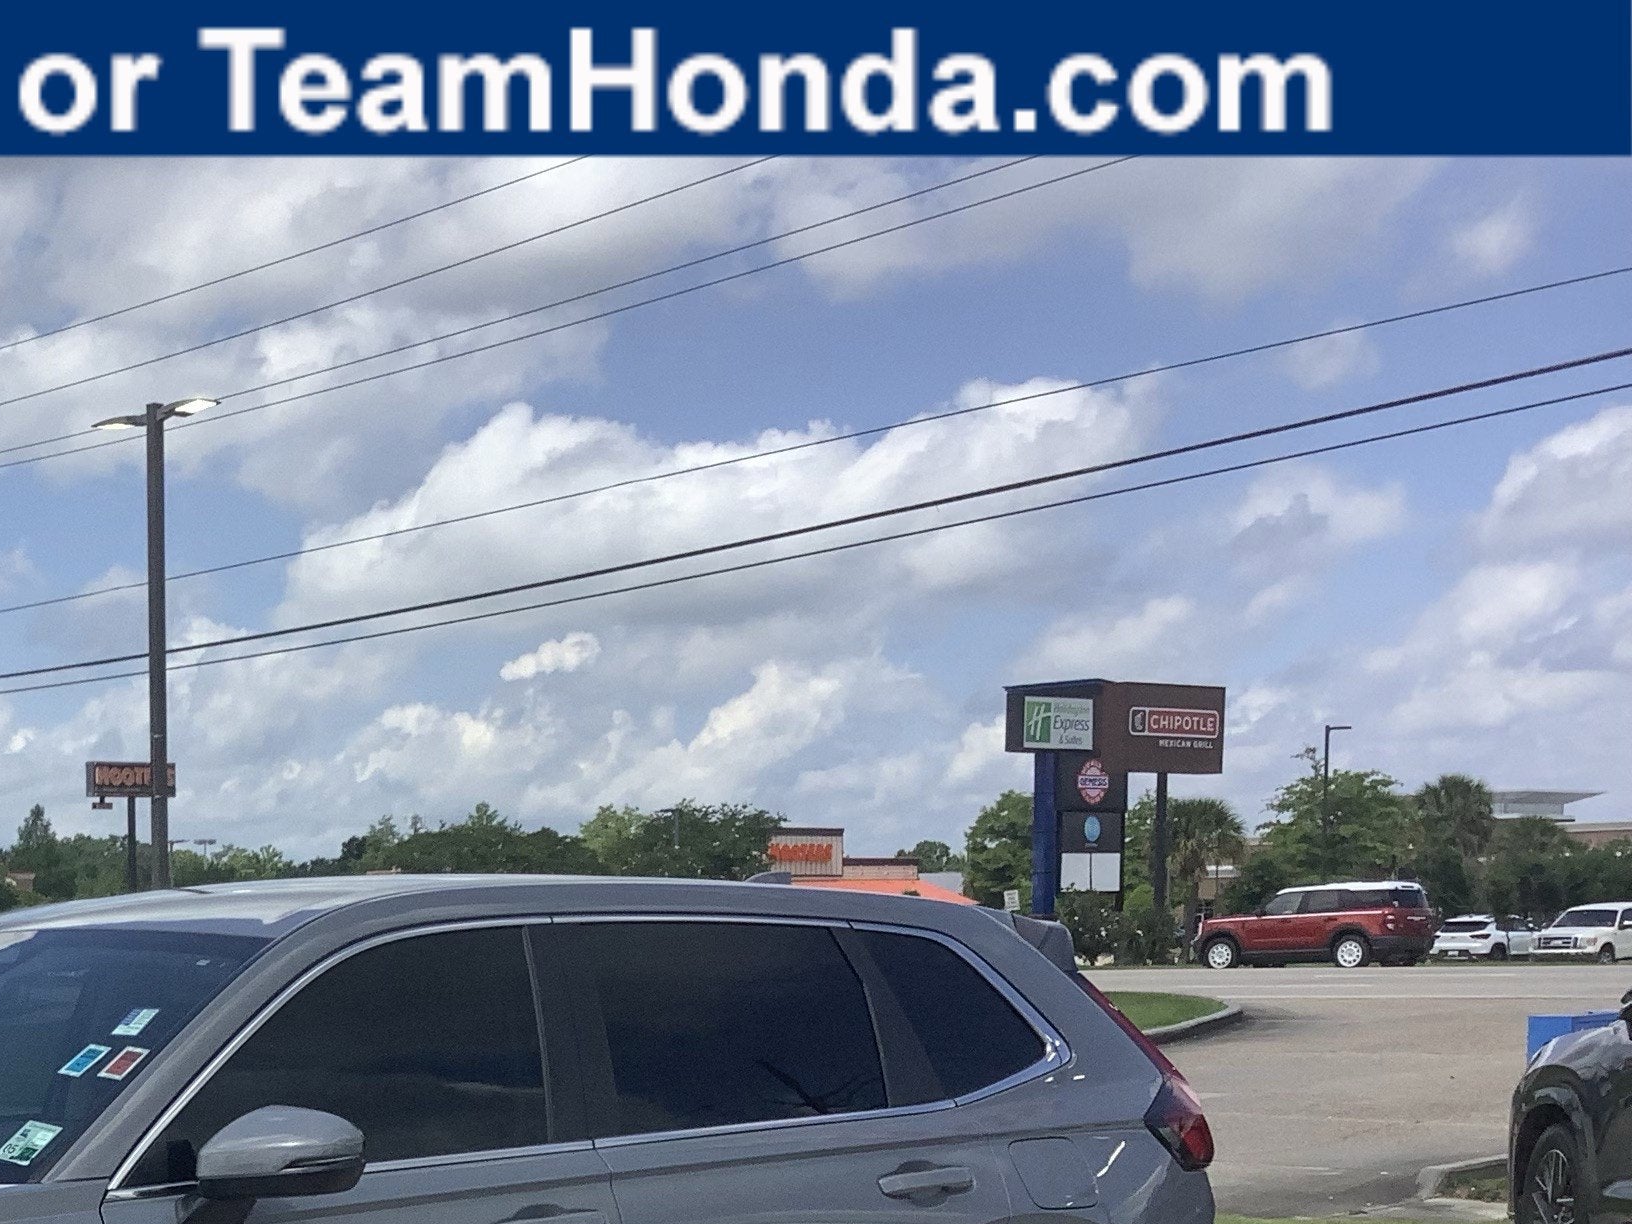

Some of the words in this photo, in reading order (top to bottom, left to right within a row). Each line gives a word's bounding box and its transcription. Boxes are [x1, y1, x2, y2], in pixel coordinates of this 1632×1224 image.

[1053, 715, 1090, 733] Express
[1150, 714, 1215, 732] CHIPOTLE
[1158, 739, 1192, 748] MEXICAN
[1193, 740, 1214, 749] GRILL
